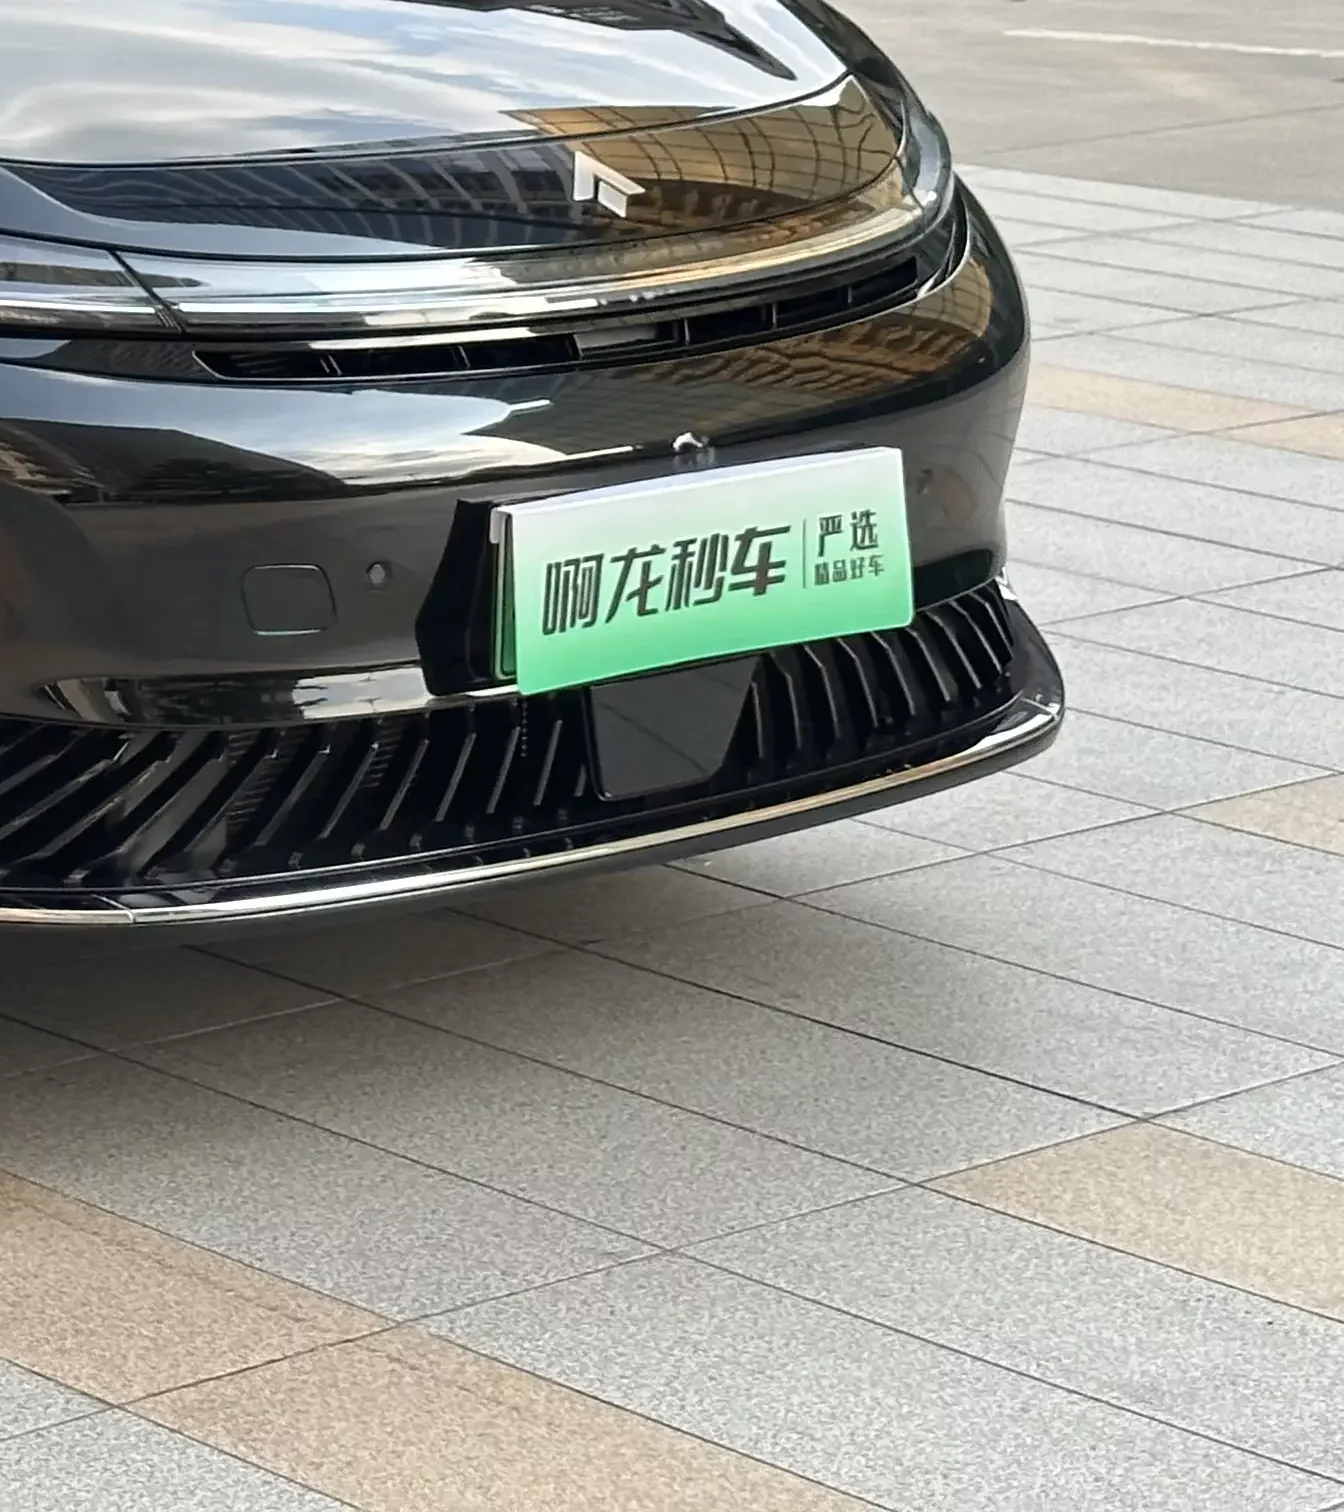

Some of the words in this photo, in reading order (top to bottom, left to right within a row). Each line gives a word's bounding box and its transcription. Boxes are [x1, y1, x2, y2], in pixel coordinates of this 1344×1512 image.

[817, 509, 880, 558] 严选
[542, 524, 792, 636] 啊龙秒车
[814, 553, 885, 586] 精品好车
